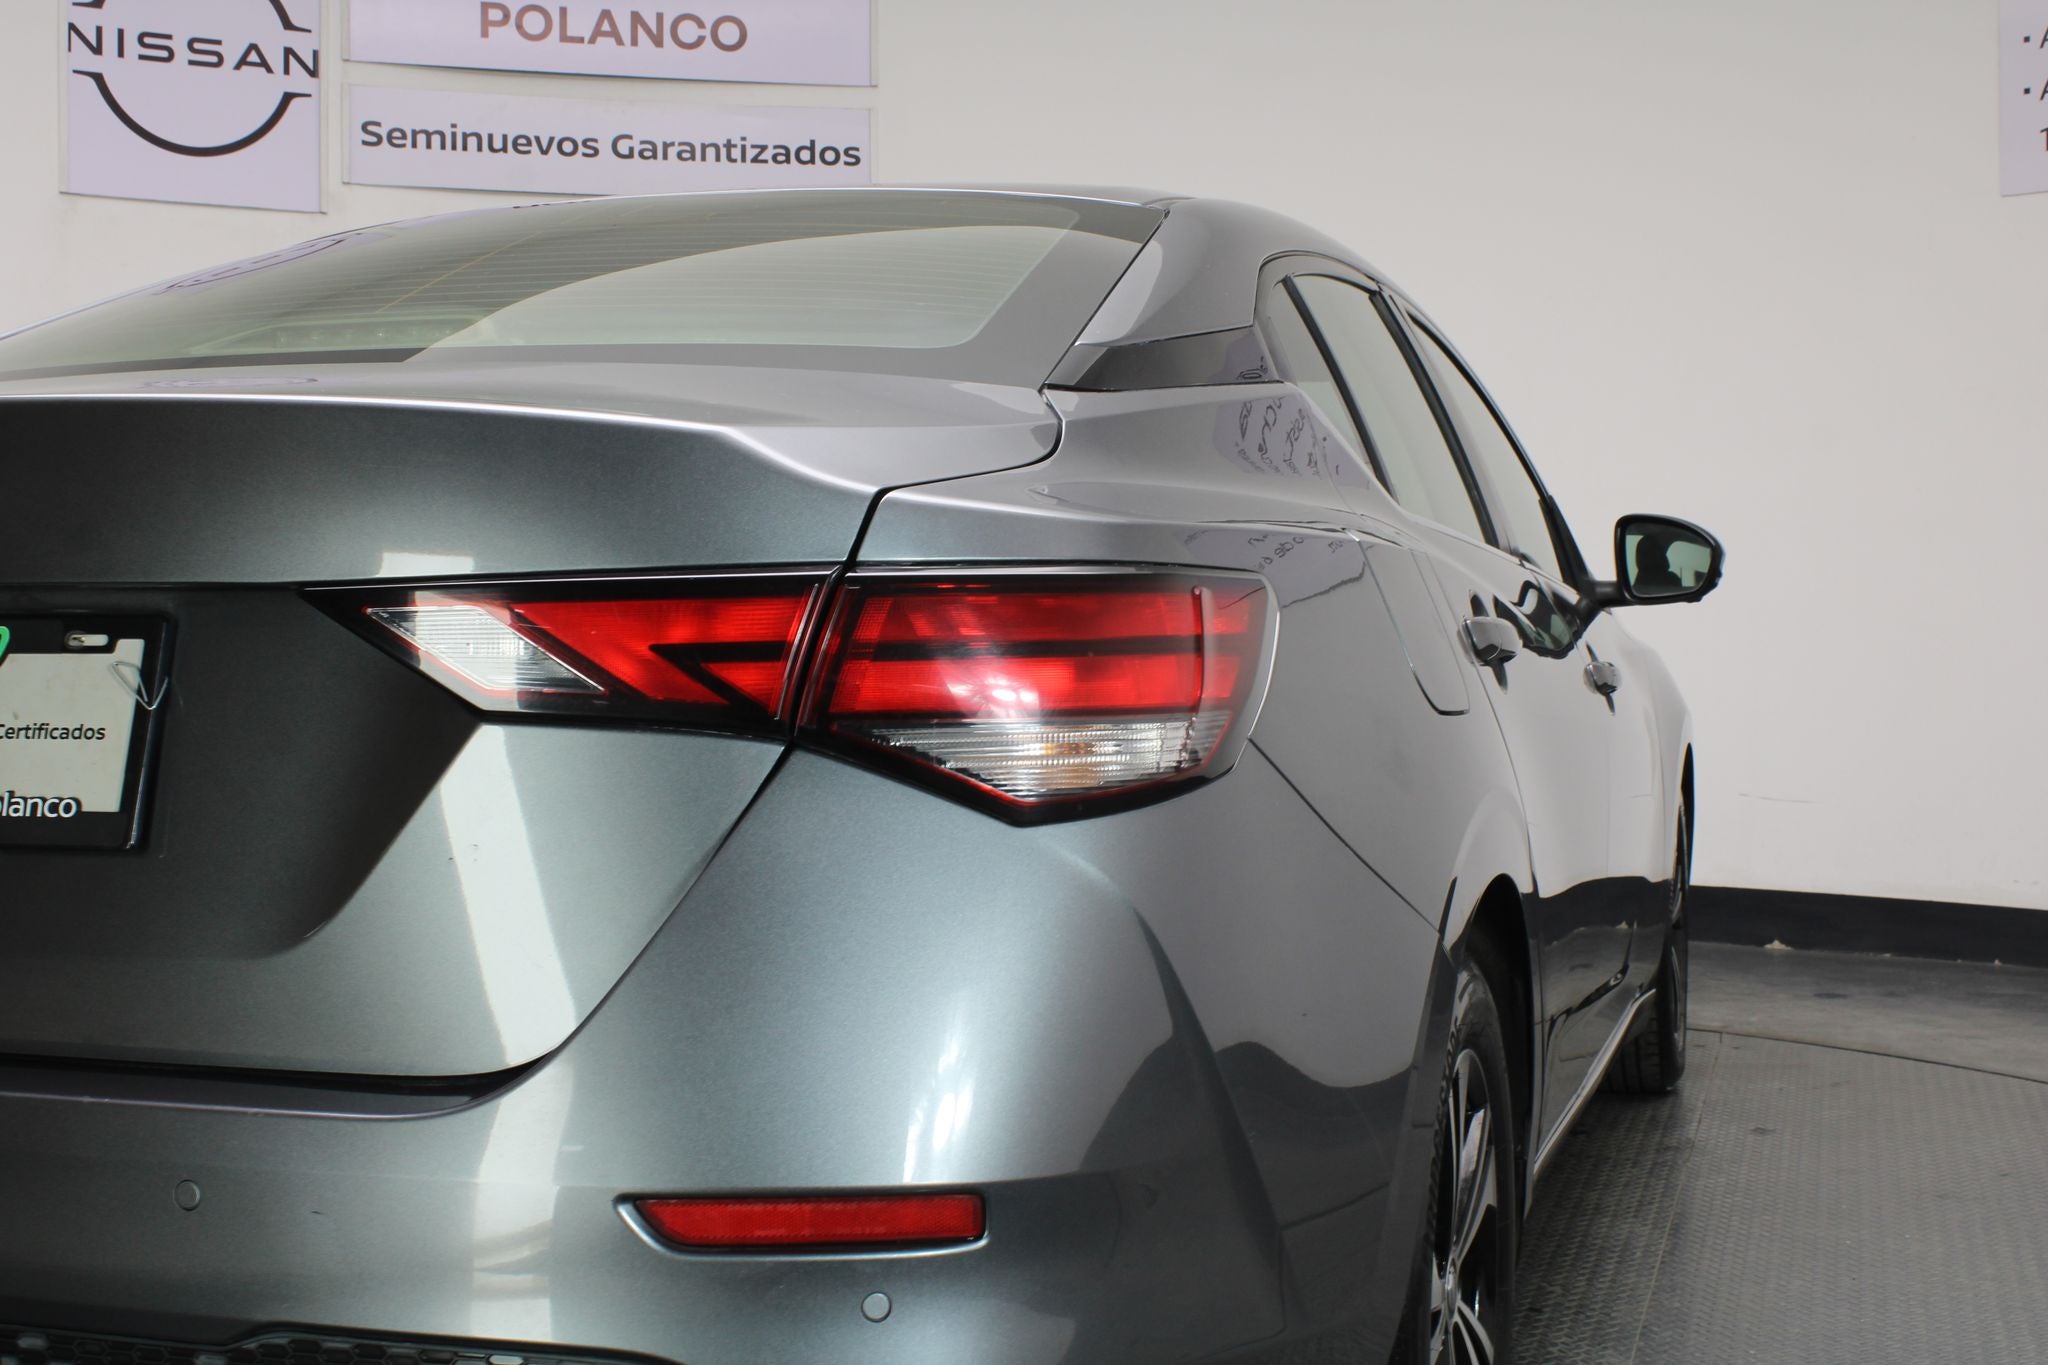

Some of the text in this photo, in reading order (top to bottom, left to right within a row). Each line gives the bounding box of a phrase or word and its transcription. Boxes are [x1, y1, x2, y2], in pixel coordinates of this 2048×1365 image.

[68, 22, 319, 78] NISSAN
[480, 1, 747, 52] POLANCO
[360, 120, 861, 166] Seminuevos Garantizados
[0, 791, 78, 818] lanco
